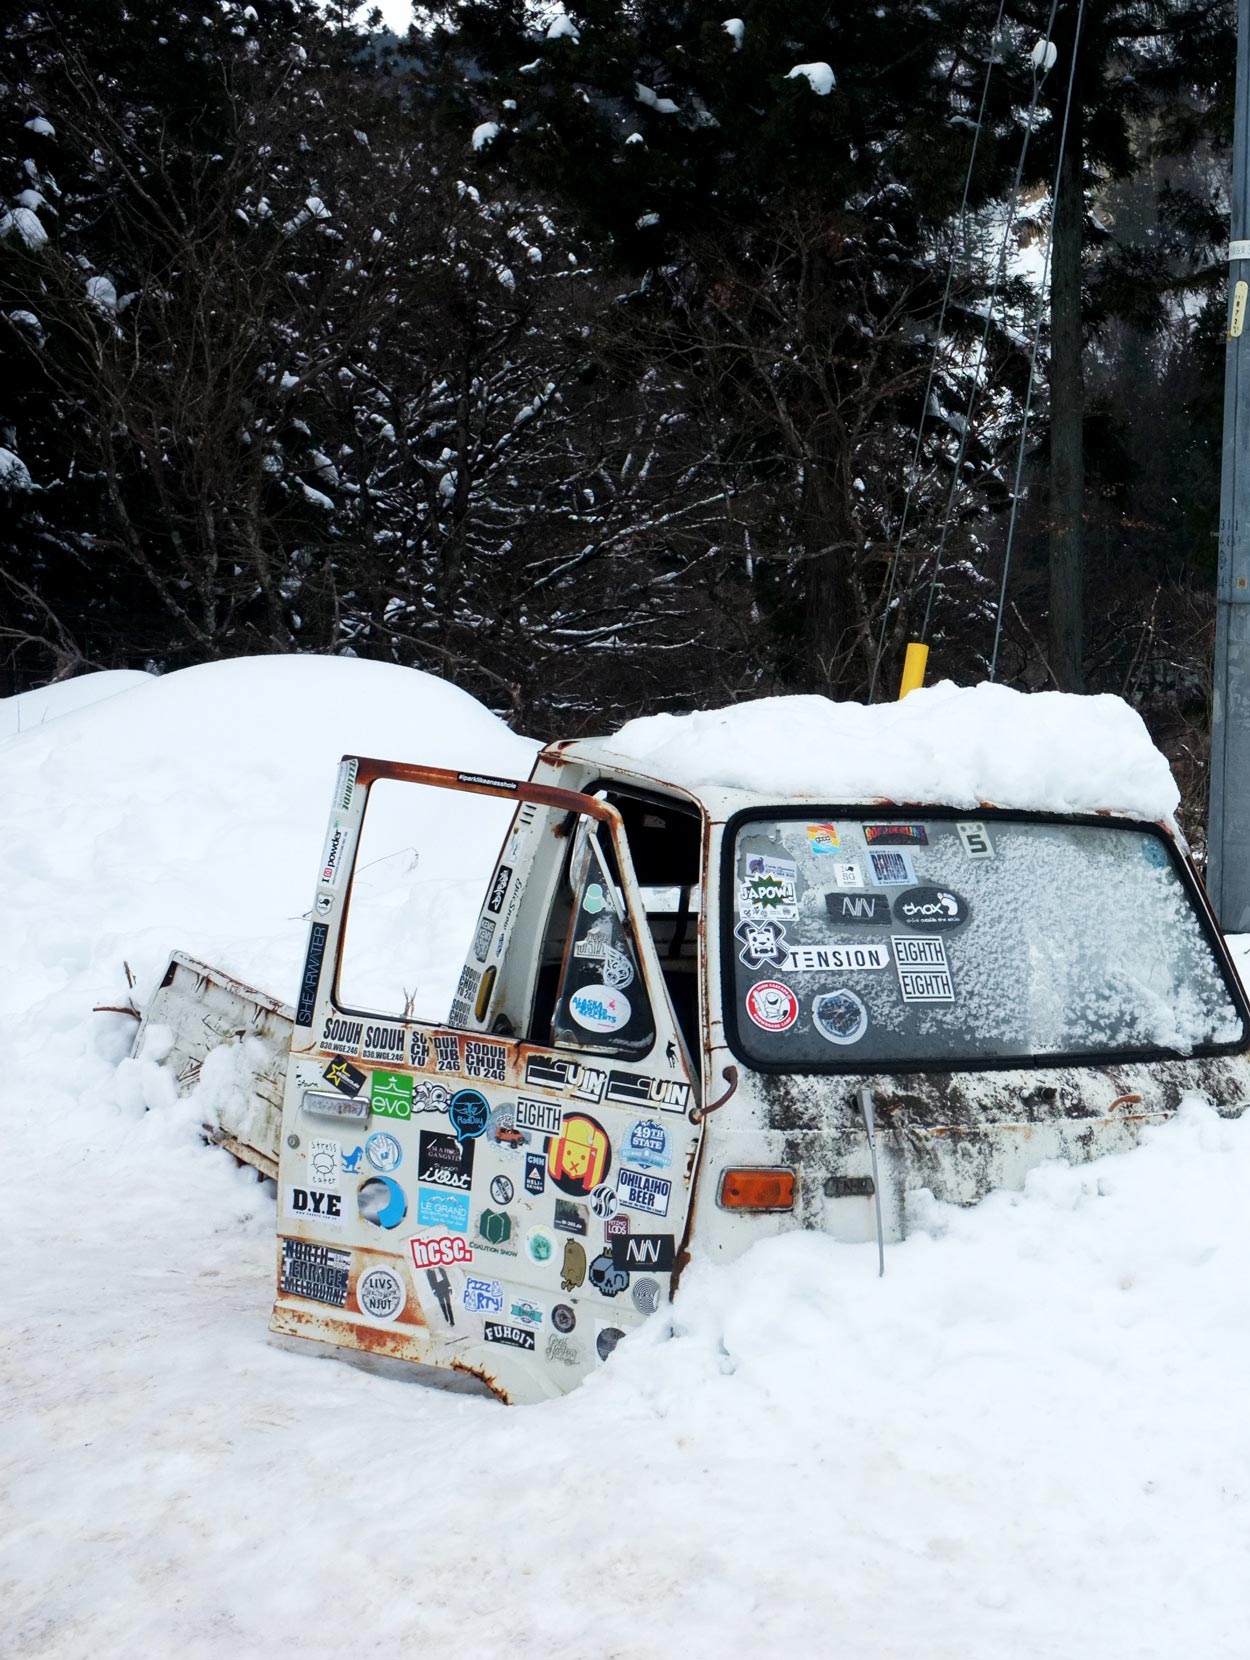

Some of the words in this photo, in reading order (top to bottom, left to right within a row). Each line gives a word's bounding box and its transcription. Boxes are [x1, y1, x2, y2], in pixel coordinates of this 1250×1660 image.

[327, 830, 342, 869] powder
[741, 882, 795, 901] JAPOW!
[901, 901, 944, 916] thox
[789, 949, 882, 969] TENSION
[894, 941, 944, 963] EIGHTH
[299, 925, 326, 1023] SHEARWATER
[901, 974, 951, 996] EIGHTH
[572, 996, 603, 1009] ALASKA
[323, 1017, 364, 1045] SODUH
[364, 1025, 405, 1052] SODUH
[465, 1041, 506, 1060] SODUH
[465, 1053, 506, 1071] CHUB
[466, 1065, 481, 1077] YU
[483, 1068, 506, 1082] 246
[371, 1096, 411, 1117] evo
[516, 1101, 562, 1131] EIGHTH
[634, 1126, 665, 1139] 49TH
[632, 1138, 663, 1150] STATE
[620, 1171, 669, 1197] OH!LA!HO
[628, 1187, 656, 1207] BEER
[420, 1201, 433, 1210] LE
[434, 1203, 467, 1217] GRAND
[285, 1239, 329, 1266] NORTH
[469, 1241, 499, 1254] COALITION
[500, 1249, 519, 1258] SNOW
[283, 1276, 347, 1306] MELBOURNE
[369, 1278, 392, 1290] LIVS
[369, 1299, 392, 1310] NJUT
[485, 1325, 534, 1348] FUHGIT
